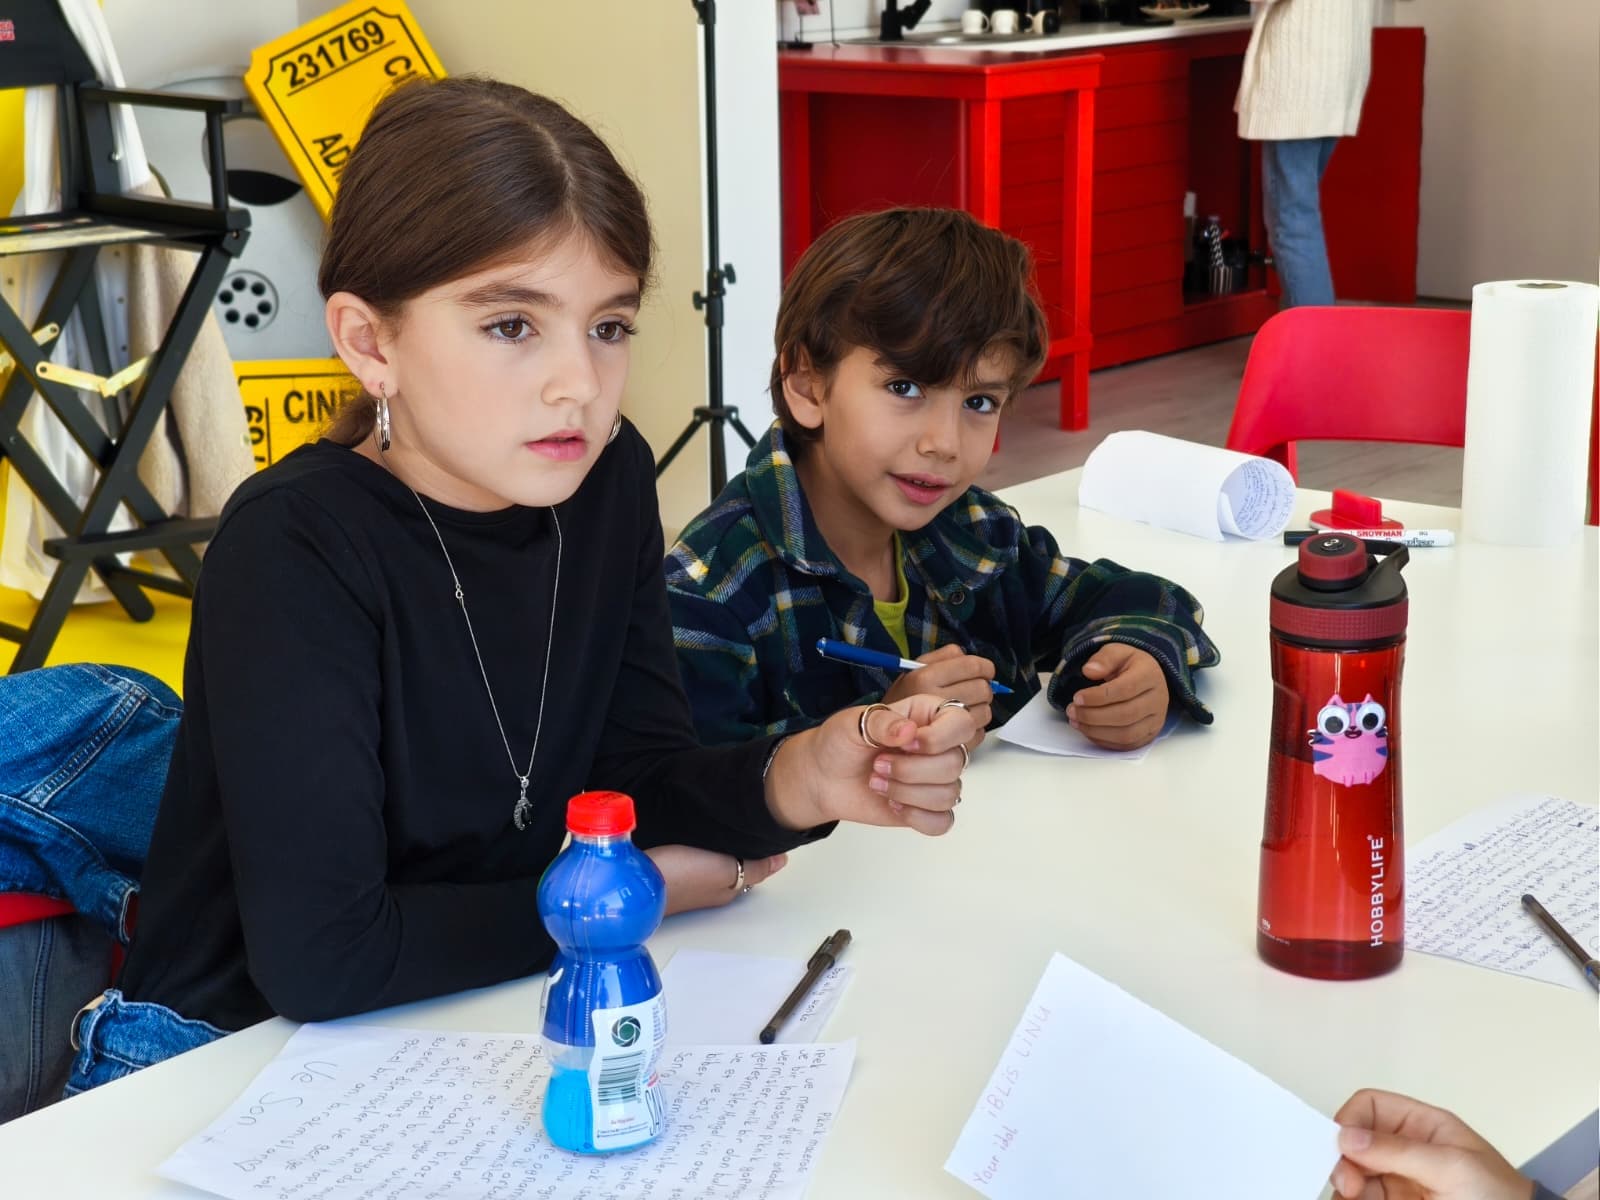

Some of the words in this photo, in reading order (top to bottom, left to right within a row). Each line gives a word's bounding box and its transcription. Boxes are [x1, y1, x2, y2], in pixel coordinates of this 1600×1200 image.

[281, 20, 385, 88] 231769
[312, 133, 351, 177] AD
[1370, 837, 1384, 947] HOBBYLIFE
[237, 1091, 304, 1128] Son
